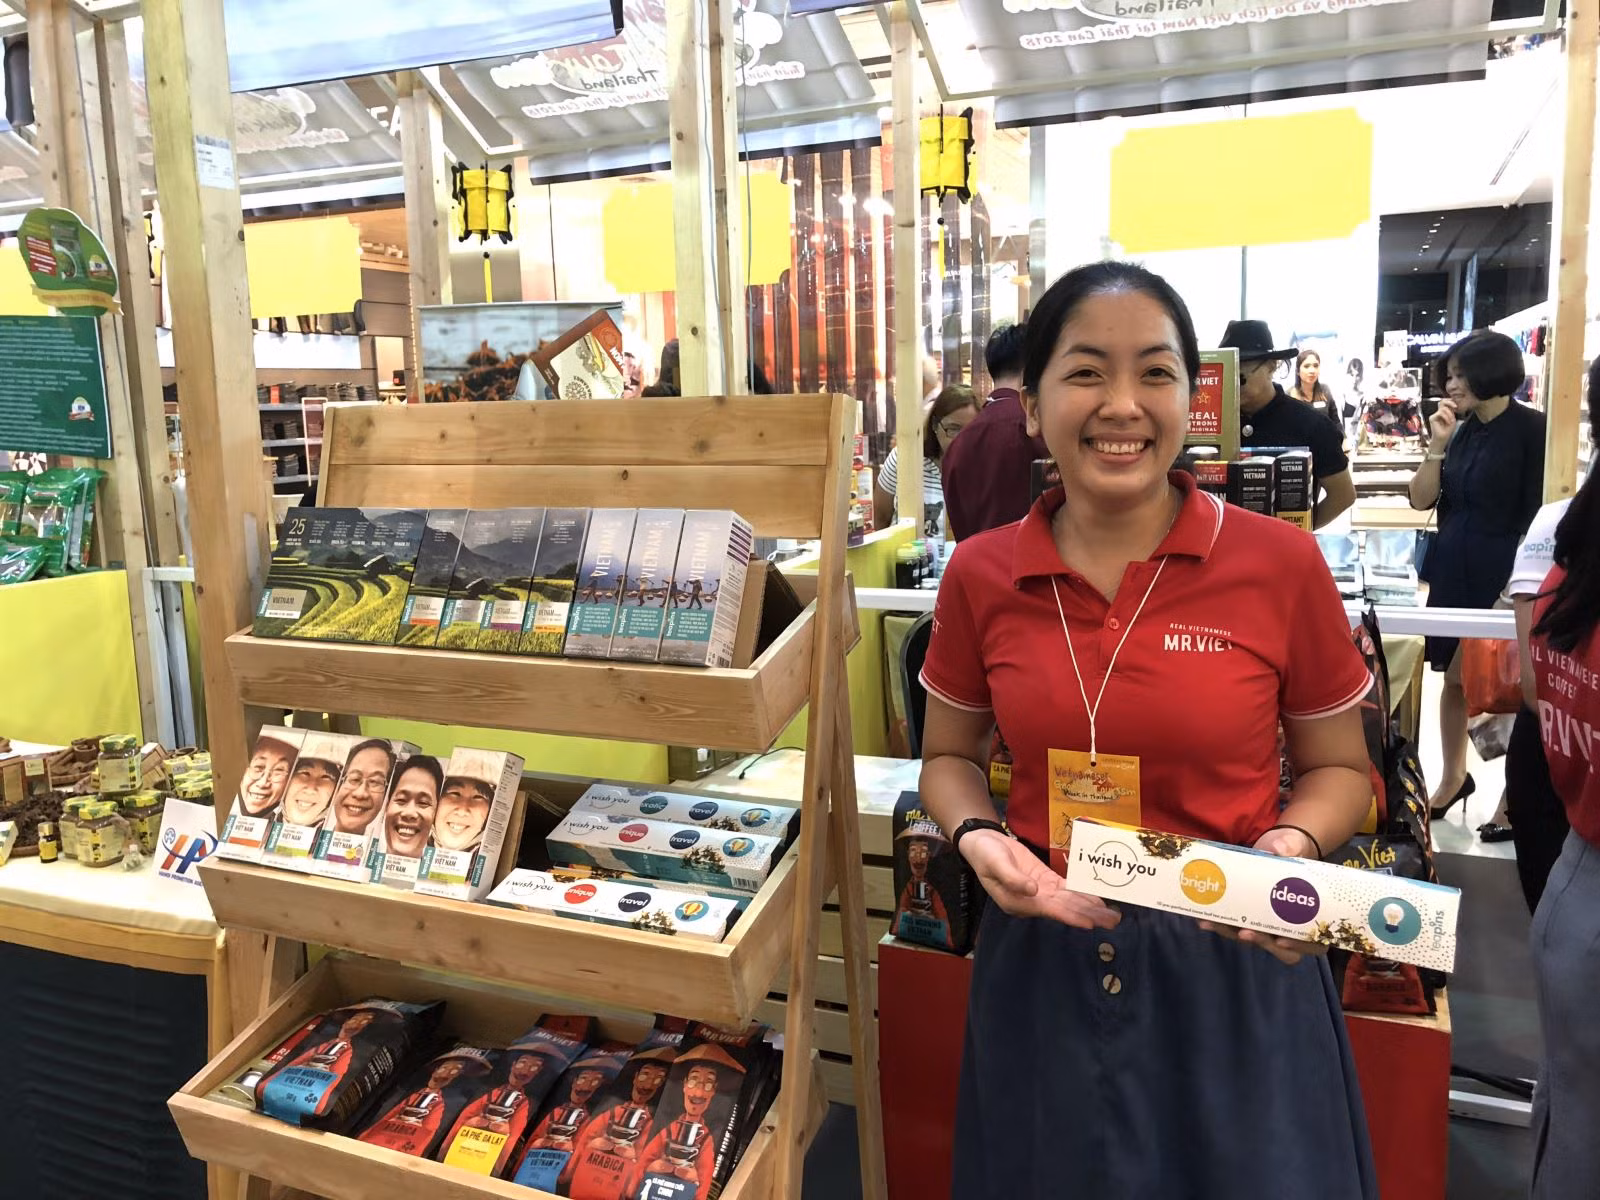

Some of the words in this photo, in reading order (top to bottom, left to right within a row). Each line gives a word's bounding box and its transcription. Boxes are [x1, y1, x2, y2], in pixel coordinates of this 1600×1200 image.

[289, 518, 307, 536] 25
[1169, 622, 1187, 631] REAL
[1188, 624, 1233, 637] VIETNAMESE
[612, 796, 631, 805] you
[571, 820, 590, 829] wish
[590, 823, 610, 832] you
[1078, 848, 1084, 863] i
[1087, 850, 1122, 870] wish
[1126, 861, 1157, 877] you
[512, 880, 533, 889] wish
[533, 883, 554, 892] you
[1180, 870, 1220, 893] bright
[620, 896, 649, 907] travel
[1271, 884, 1316, 908] ideas
[1429, 909, 1445, 952] teapins
[586, 1152, 625, 1174] ARABICA
